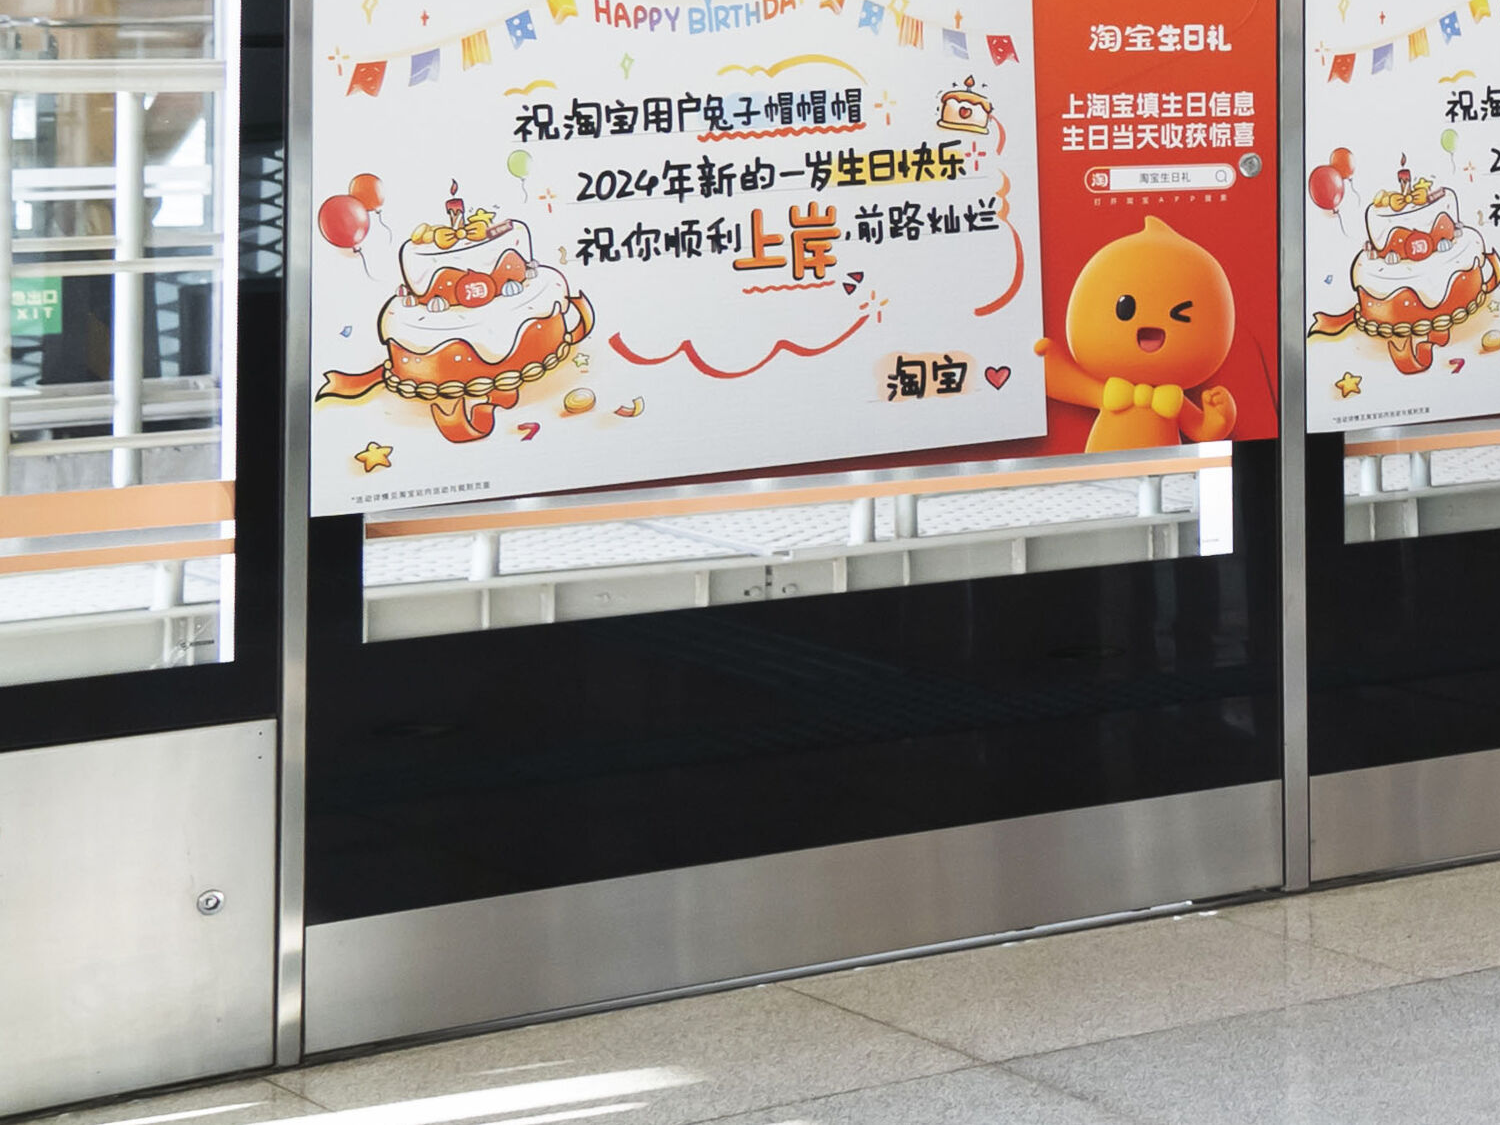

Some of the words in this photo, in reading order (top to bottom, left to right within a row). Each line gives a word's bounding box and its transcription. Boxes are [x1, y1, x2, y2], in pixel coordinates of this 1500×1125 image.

[1089, 24, 1232, 52] 淘宝生日礼
[513, 89, 863, 142] 祝淘宝用户兔子帽帽帽
[1062, 91, 1255, 119] 上淘宝填生日信息
[1062, 122, 1255, 151] 生日当天收获惊喜
[577, 142, 965, 203] 2024年新的一岁生日快乐
[1139, 172, 1191, 184] 淘宝生日礼
[464, 281, 488, 300] 淘
[16, 307, 54, 321] XIT
[887, 355, 968, 401] 淘宝
